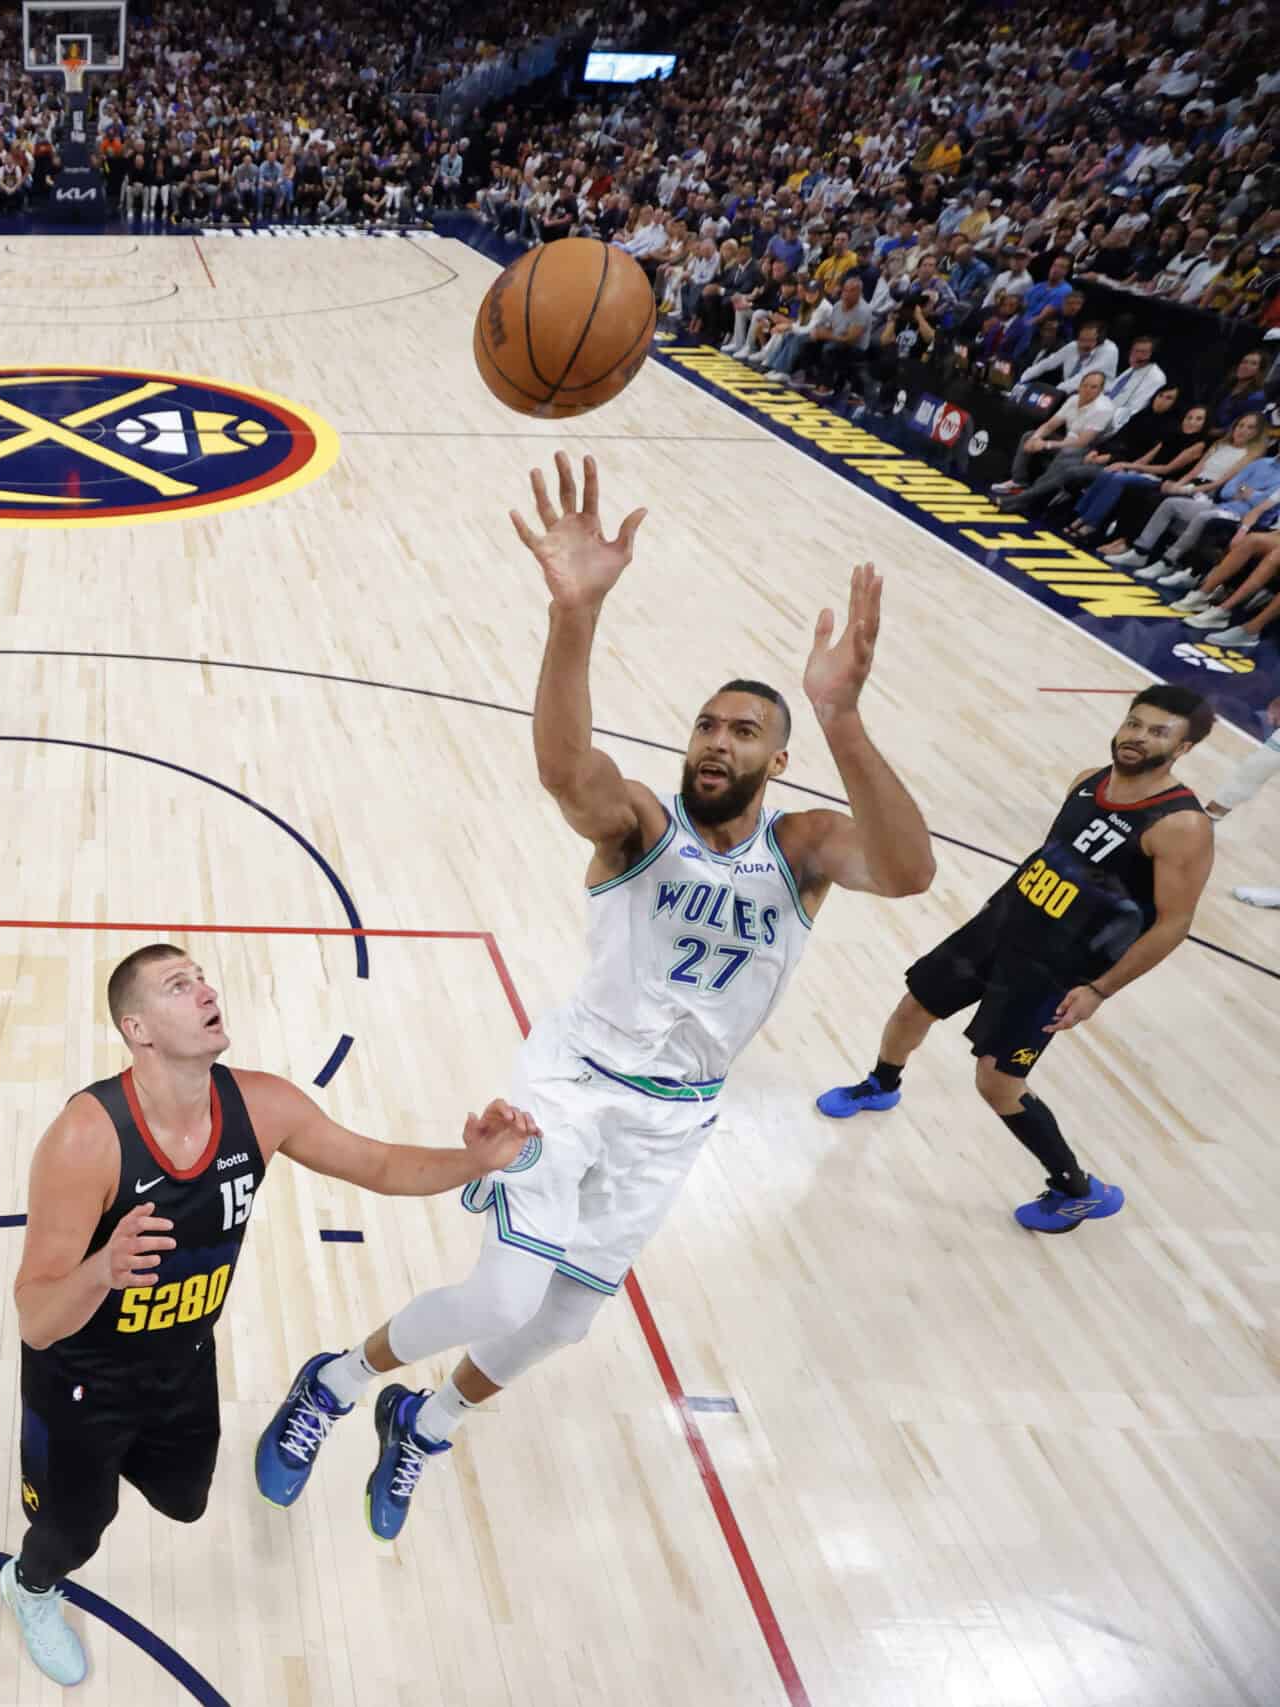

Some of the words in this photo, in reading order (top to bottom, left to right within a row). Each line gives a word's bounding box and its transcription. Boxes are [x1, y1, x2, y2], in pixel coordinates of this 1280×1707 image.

[656, 344, 906, 455] BASKETBALL
[843, 458, 1029, 524] HIGH
[958, 529, 1199, 618] MILE
[1072, 818, 1127, 864] 27
[652, 881, 779, 945] WOLES
[1016, 858, 1080, 920] 280
[667, 934, 753, 993] 27
[217, 1152, 249, 1171] ibotta
[220, 1173, 254, 1231] 15
[117, 1264, 232, 1334] 5280
